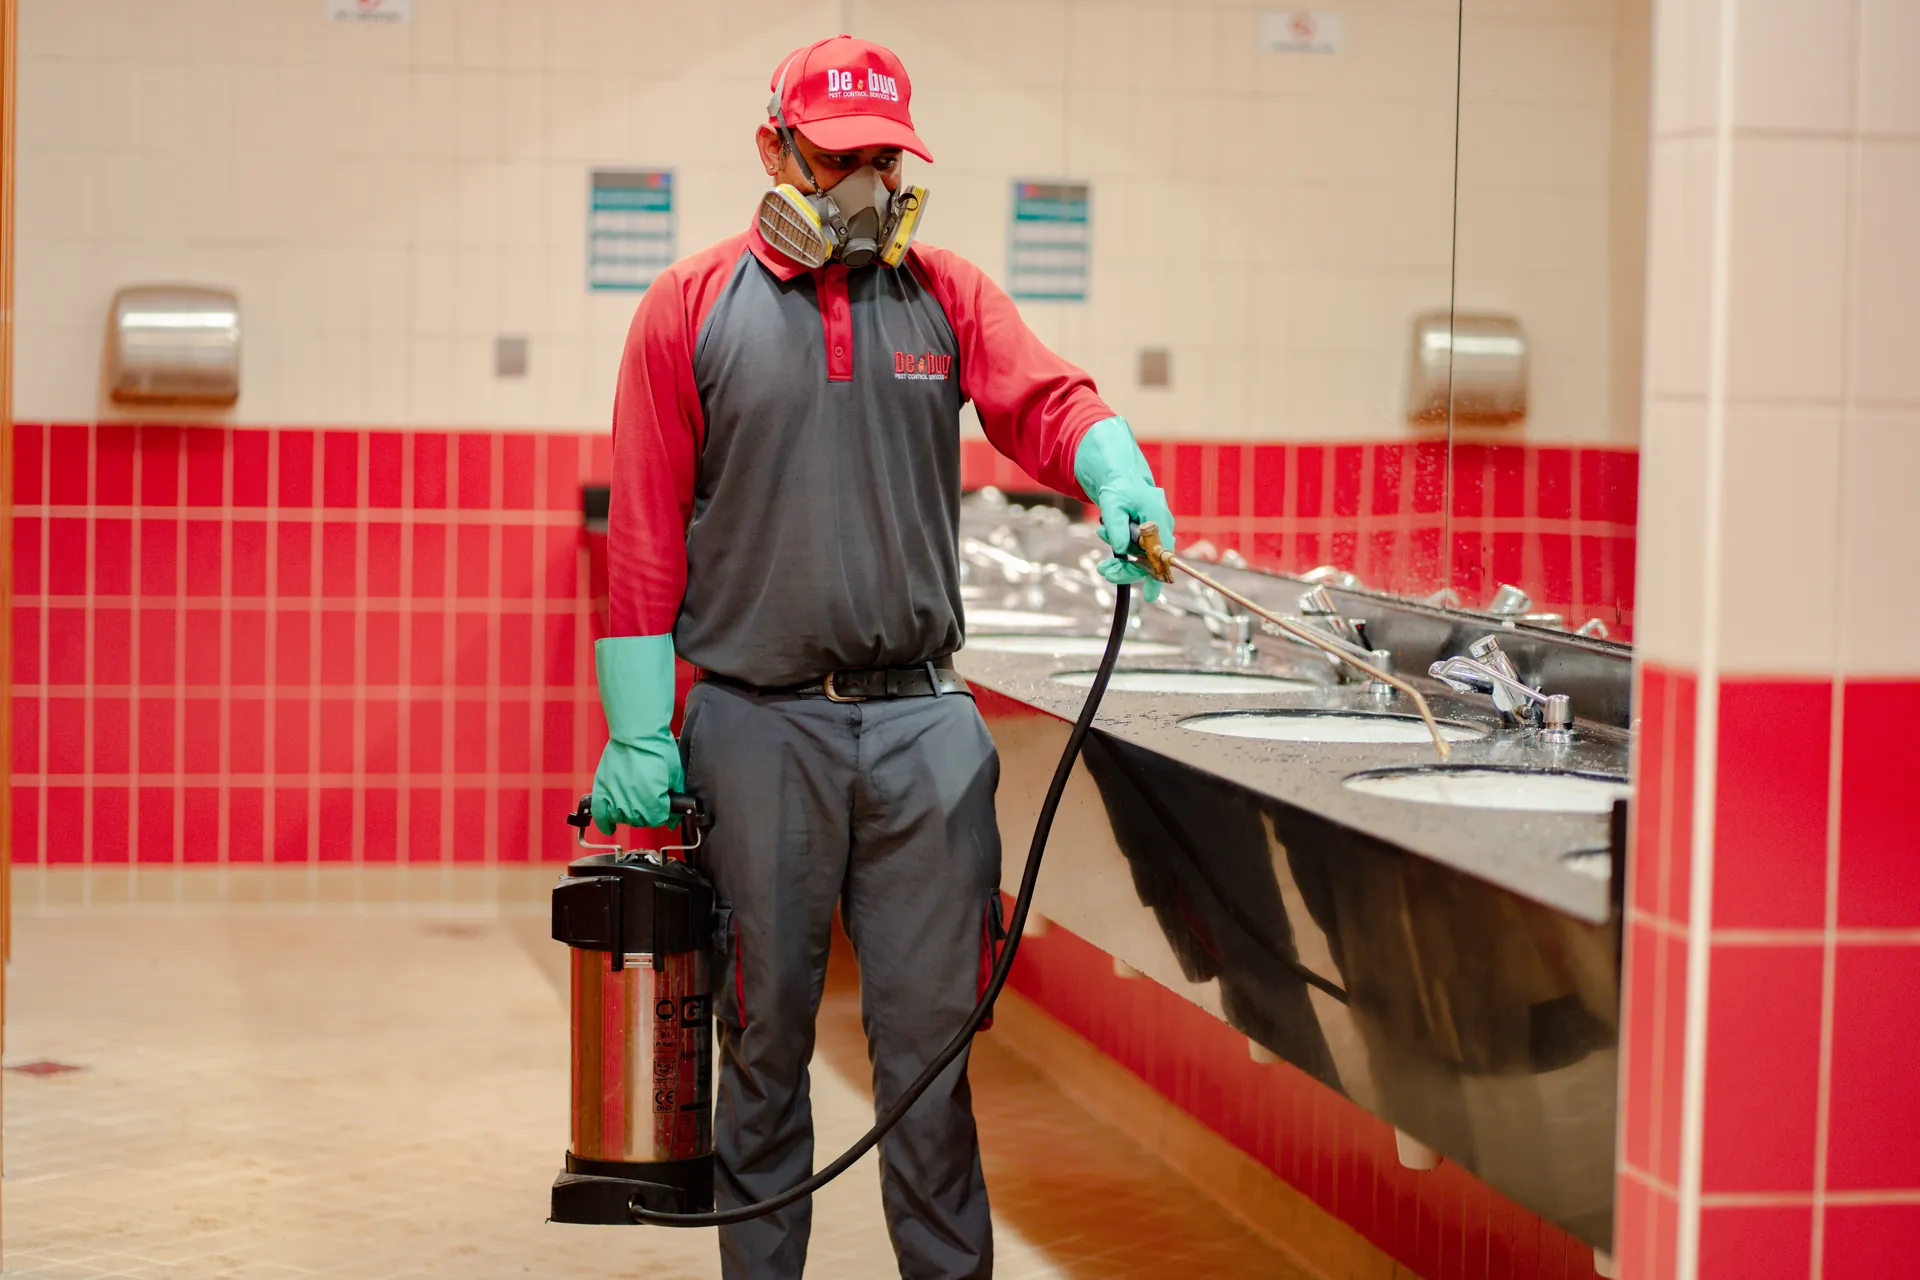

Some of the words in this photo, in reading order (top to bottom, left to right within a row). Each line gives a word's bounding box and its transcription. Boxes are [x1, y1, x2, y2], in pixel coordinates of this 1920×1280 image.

[828, 69, 852, 92] De
[868, 68, 898, 102] bug
[870, 92, 890, 100] SERVICES
[894, 351, 915, 373] De
[927, 350, 953, 380] bug
